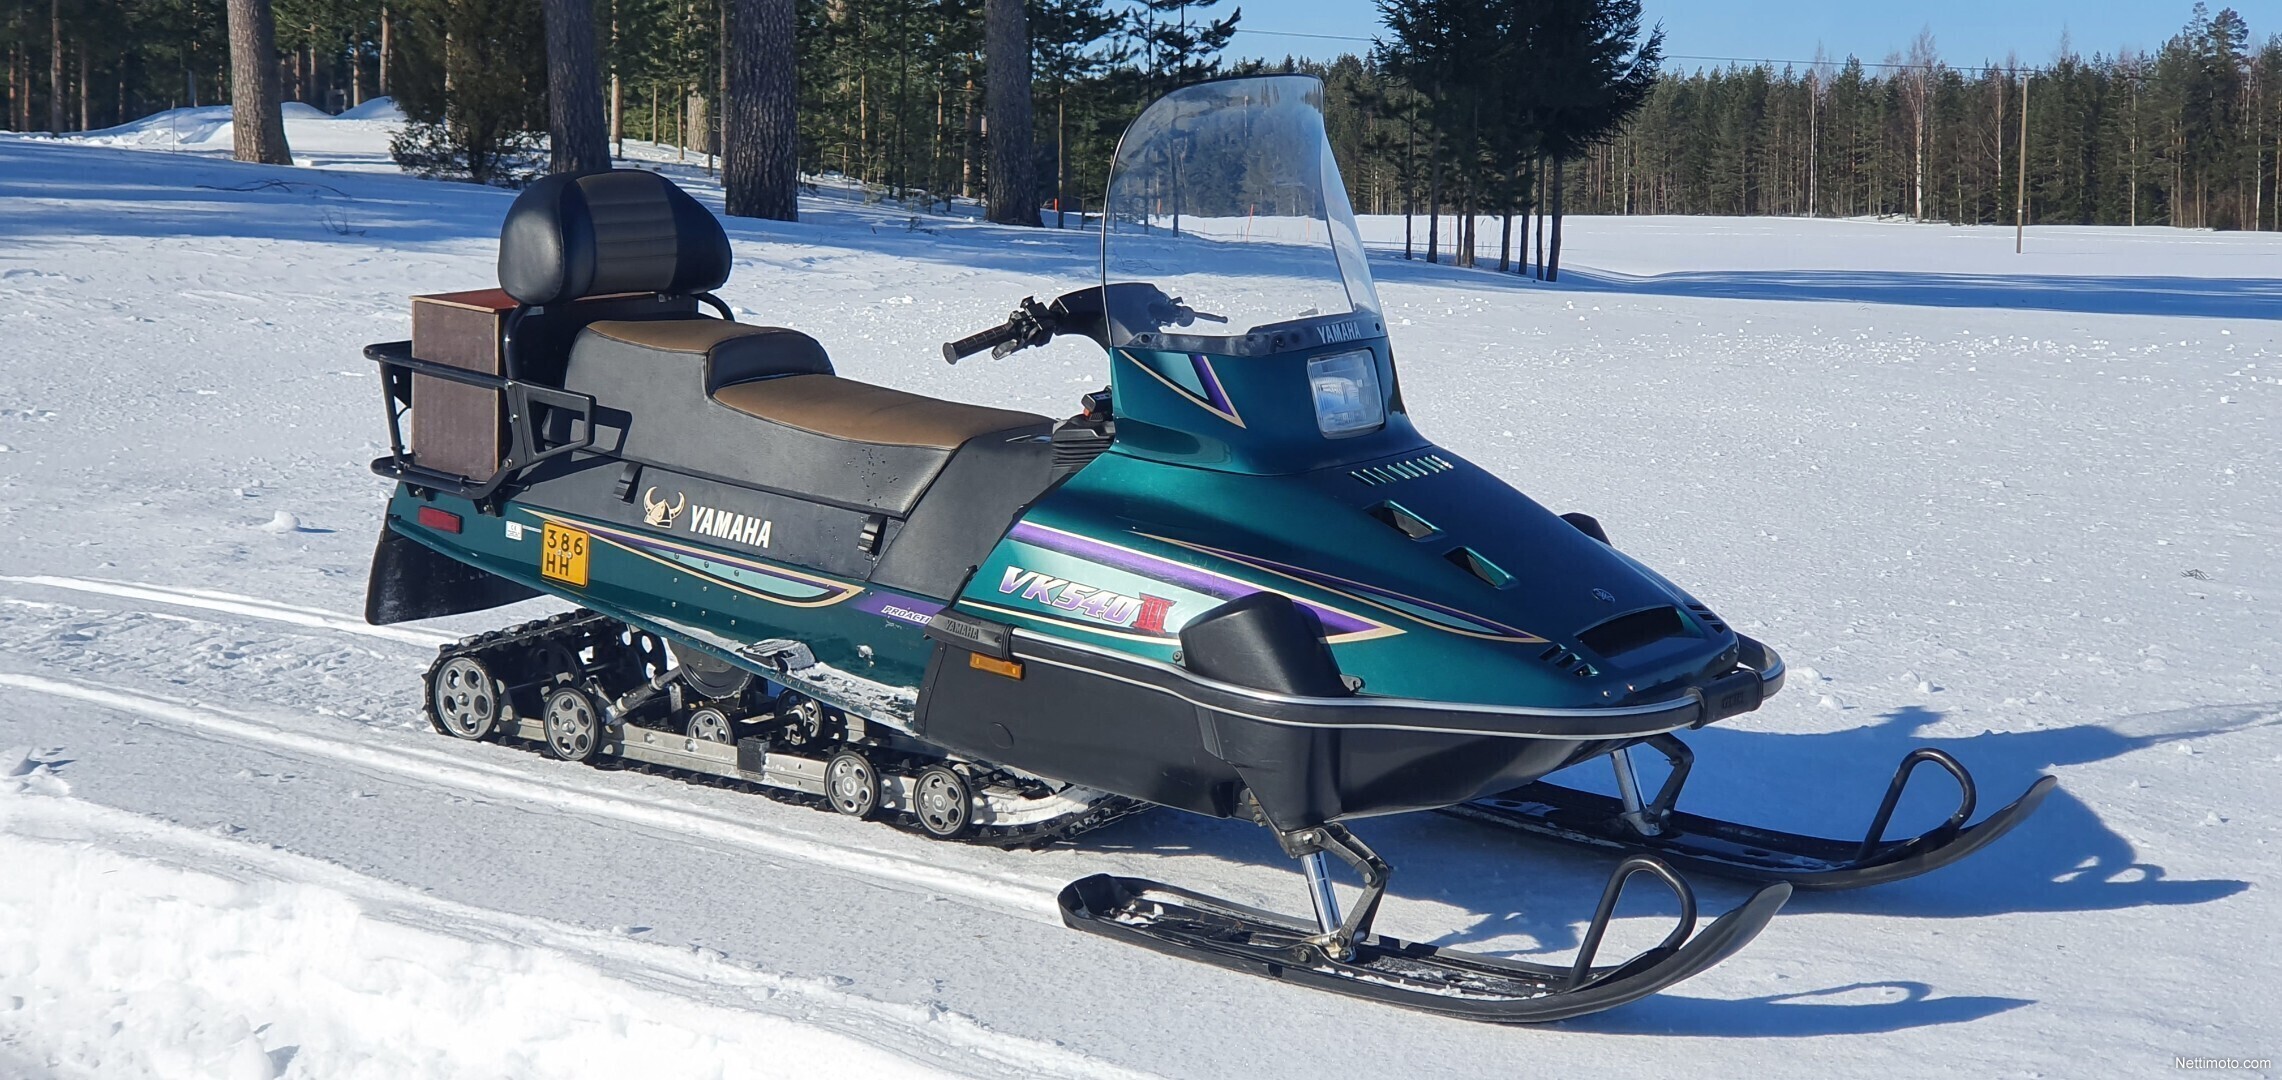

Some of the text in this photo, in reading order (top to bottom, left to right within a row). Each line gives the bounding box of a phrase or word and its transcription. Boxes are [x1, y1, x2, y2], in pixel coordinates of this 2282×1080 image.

[1317, 321, 1361, 344] YAMAHA
[690, 505, 772, 549] YAMAHA
[547, 529, 583, 556] 386
[546, 552, 569, 576] HH
[946, 619, 979, 640] YAMAHA
